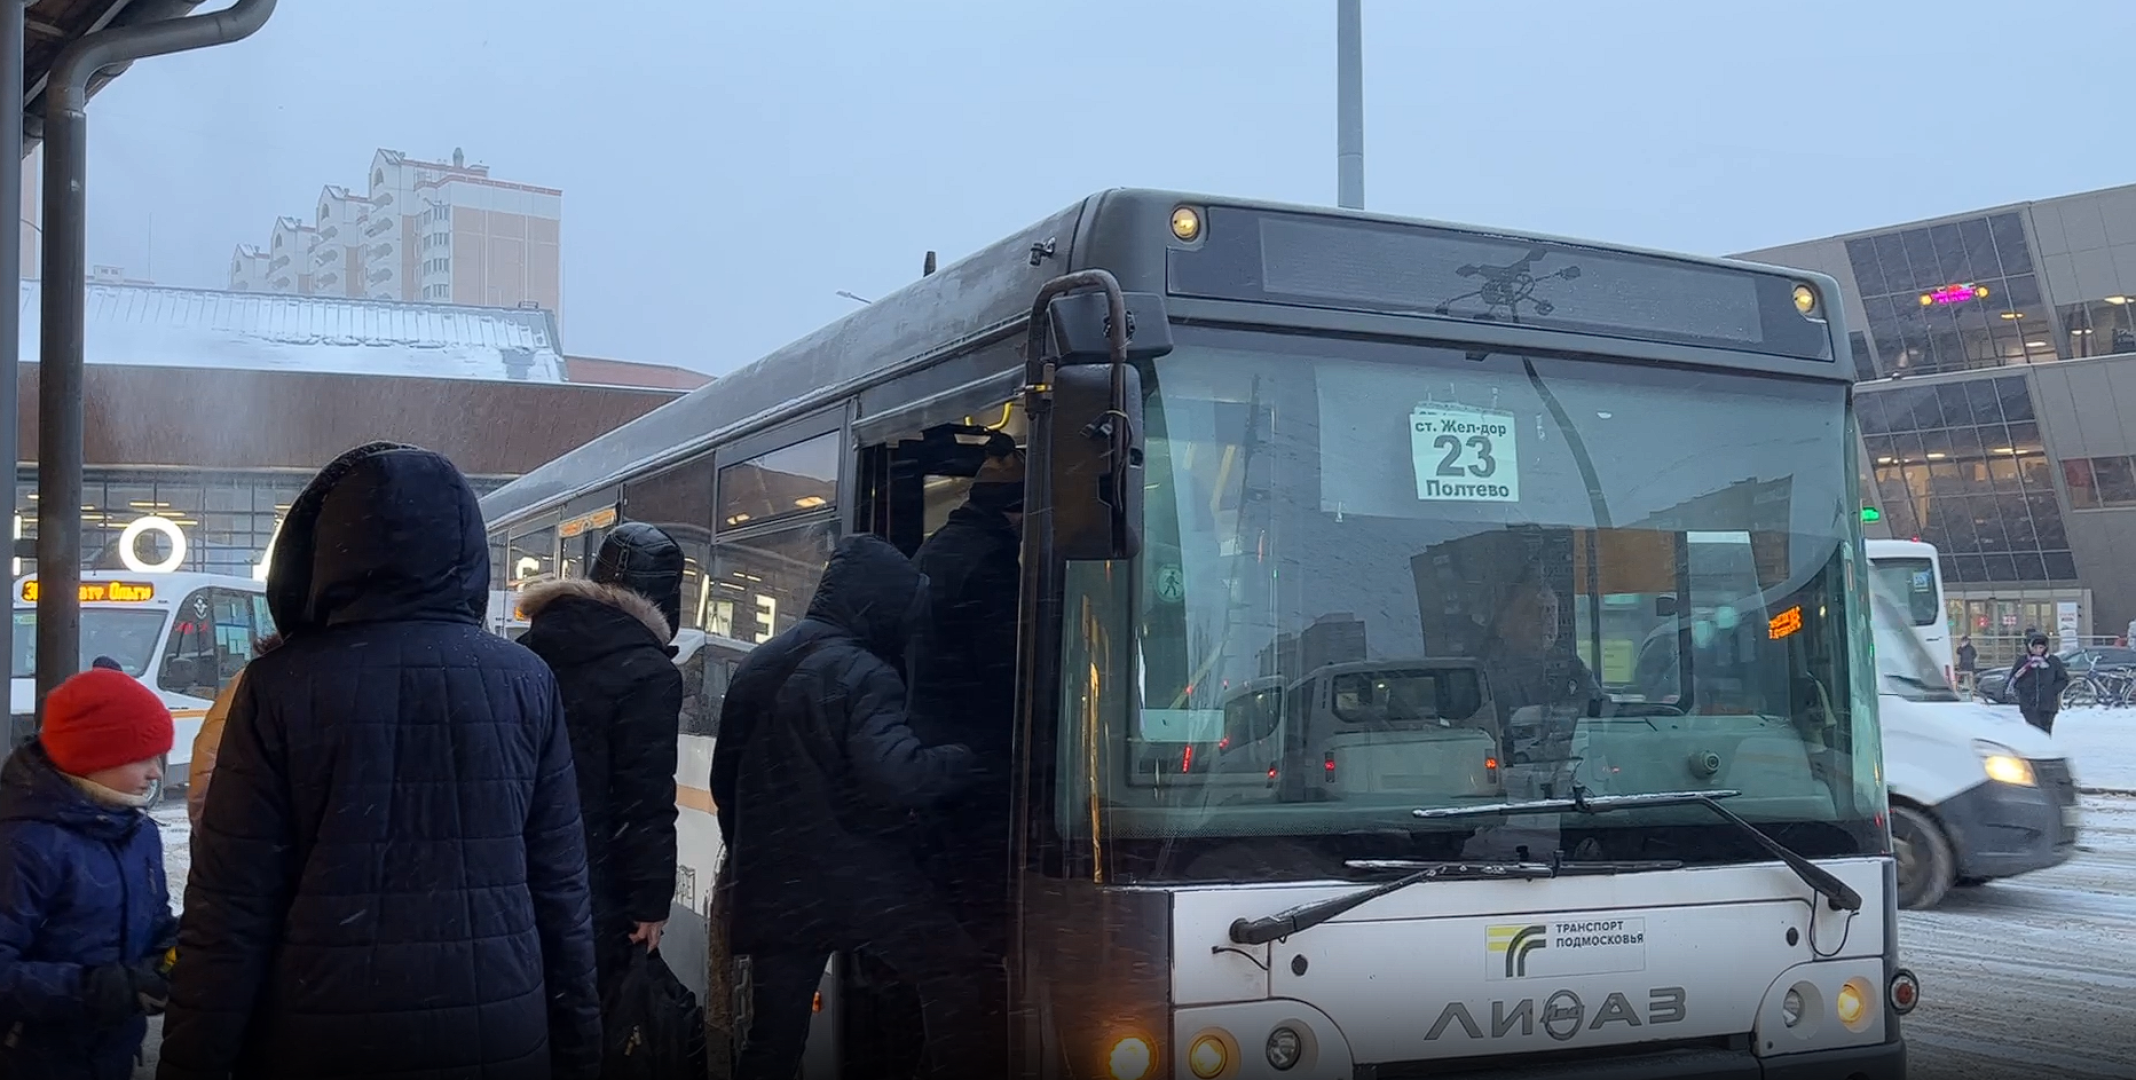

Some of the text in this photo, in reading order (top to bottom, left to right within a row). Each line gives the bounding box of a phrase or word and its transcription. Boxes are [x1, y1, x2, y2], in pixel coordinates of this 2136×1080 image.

[1415, 419, 1506, 437] ст. Жел-дор
[1433, 435, 1497, 479] 23
[1426, 480, 1510, 498] Полтево
[1556, 921, 1624, 934] ТРАНСПОРТ
[1556, 933, 1644, 948] ПОДМОСКОВЬЯ
